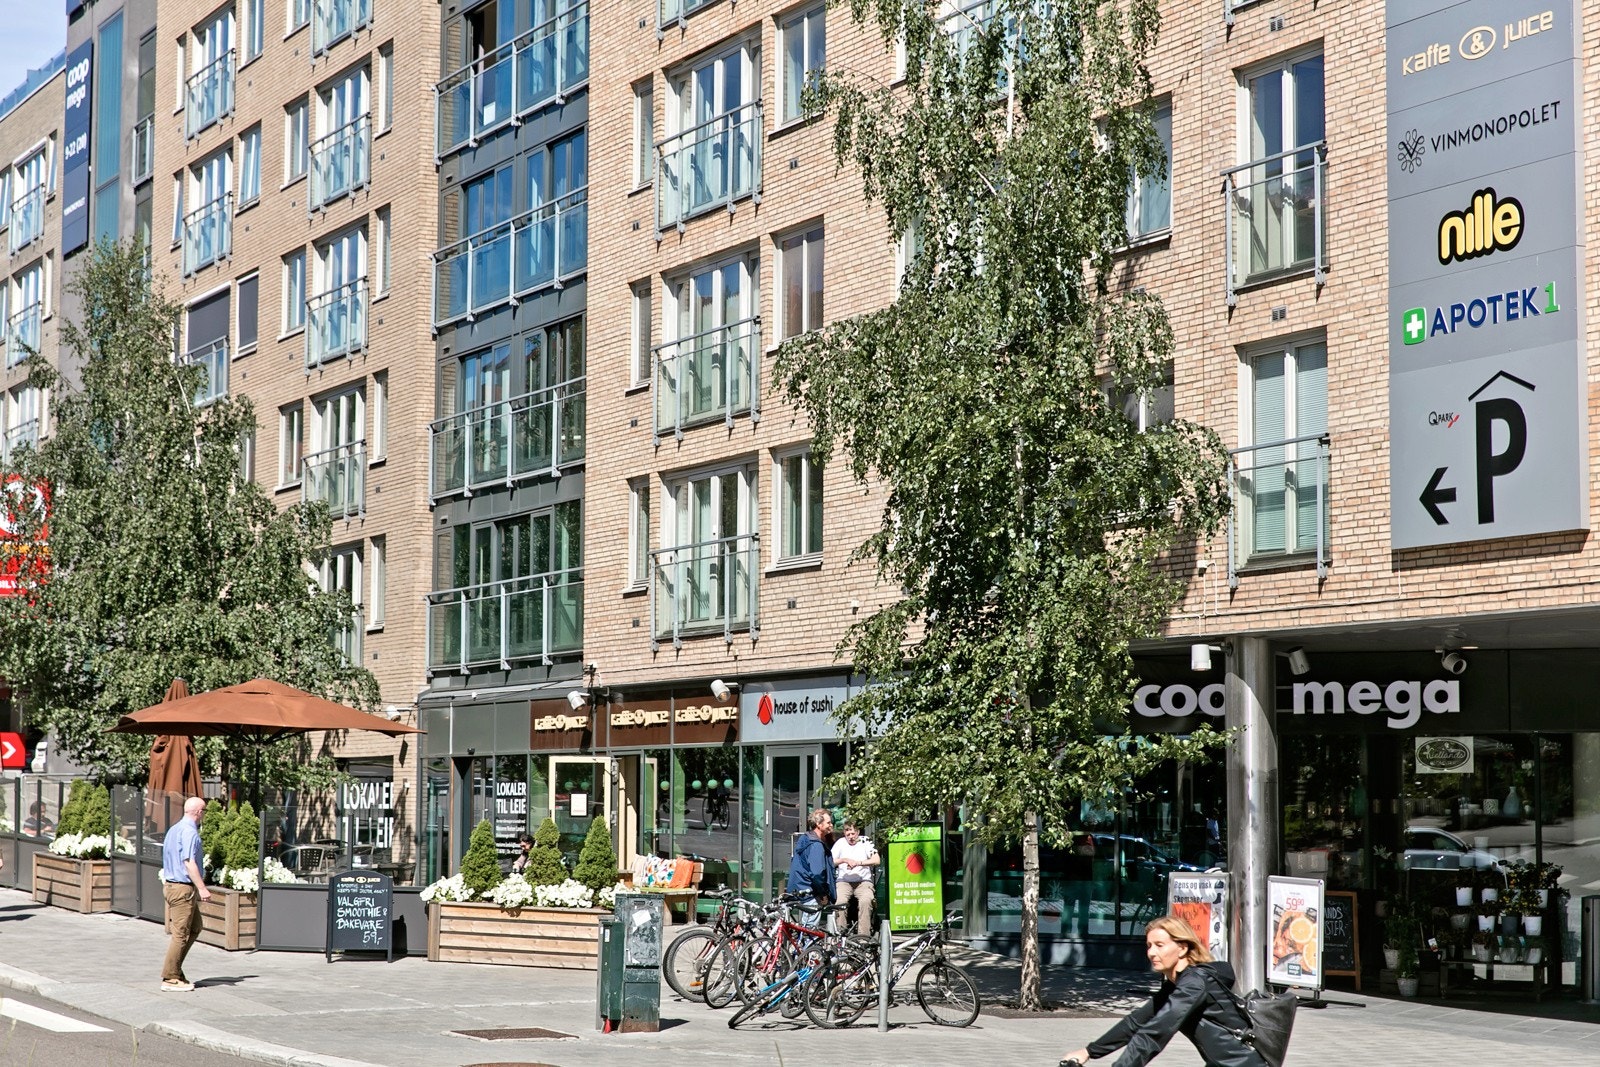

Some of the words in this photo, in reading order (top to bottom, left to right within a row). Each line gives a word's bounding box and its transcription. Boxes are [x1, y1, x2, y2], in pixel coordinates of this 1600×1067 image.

[1503, 10, 1553, 49] juice
[67, 57, 89, 88] coop
[66, 84, 86, 110] mega
[1431, 101, 1561, 153] VINMONOPOLET
[1439, 188, 1524, 265] nille
[1430, 286, 1541, 337] APOTEK
[1544, 281, 1561, 314] 1
[1475, 397, 1527, 524] P
[774, 699, 798, 715] house
[800, 696, 809, 714] of
[811, 695, 833, 713] sushi
[1133, 684, 1226, 717] coo
[1293, 679, 1460, 729] mega
[496, 782, 527, 796] LOKALER
[496, 798, 508, 814] TIL
[510, 798, 527, 814] LEIE
[342, 817, 362, 847] TL
[336, 906, 382, 917] SMOOTHIE
[337, 896, 375, 907] VALGFRI
[336, 918, 384, 931] BAKEVARE
[895, 914, 936, 925] ELIXIA
